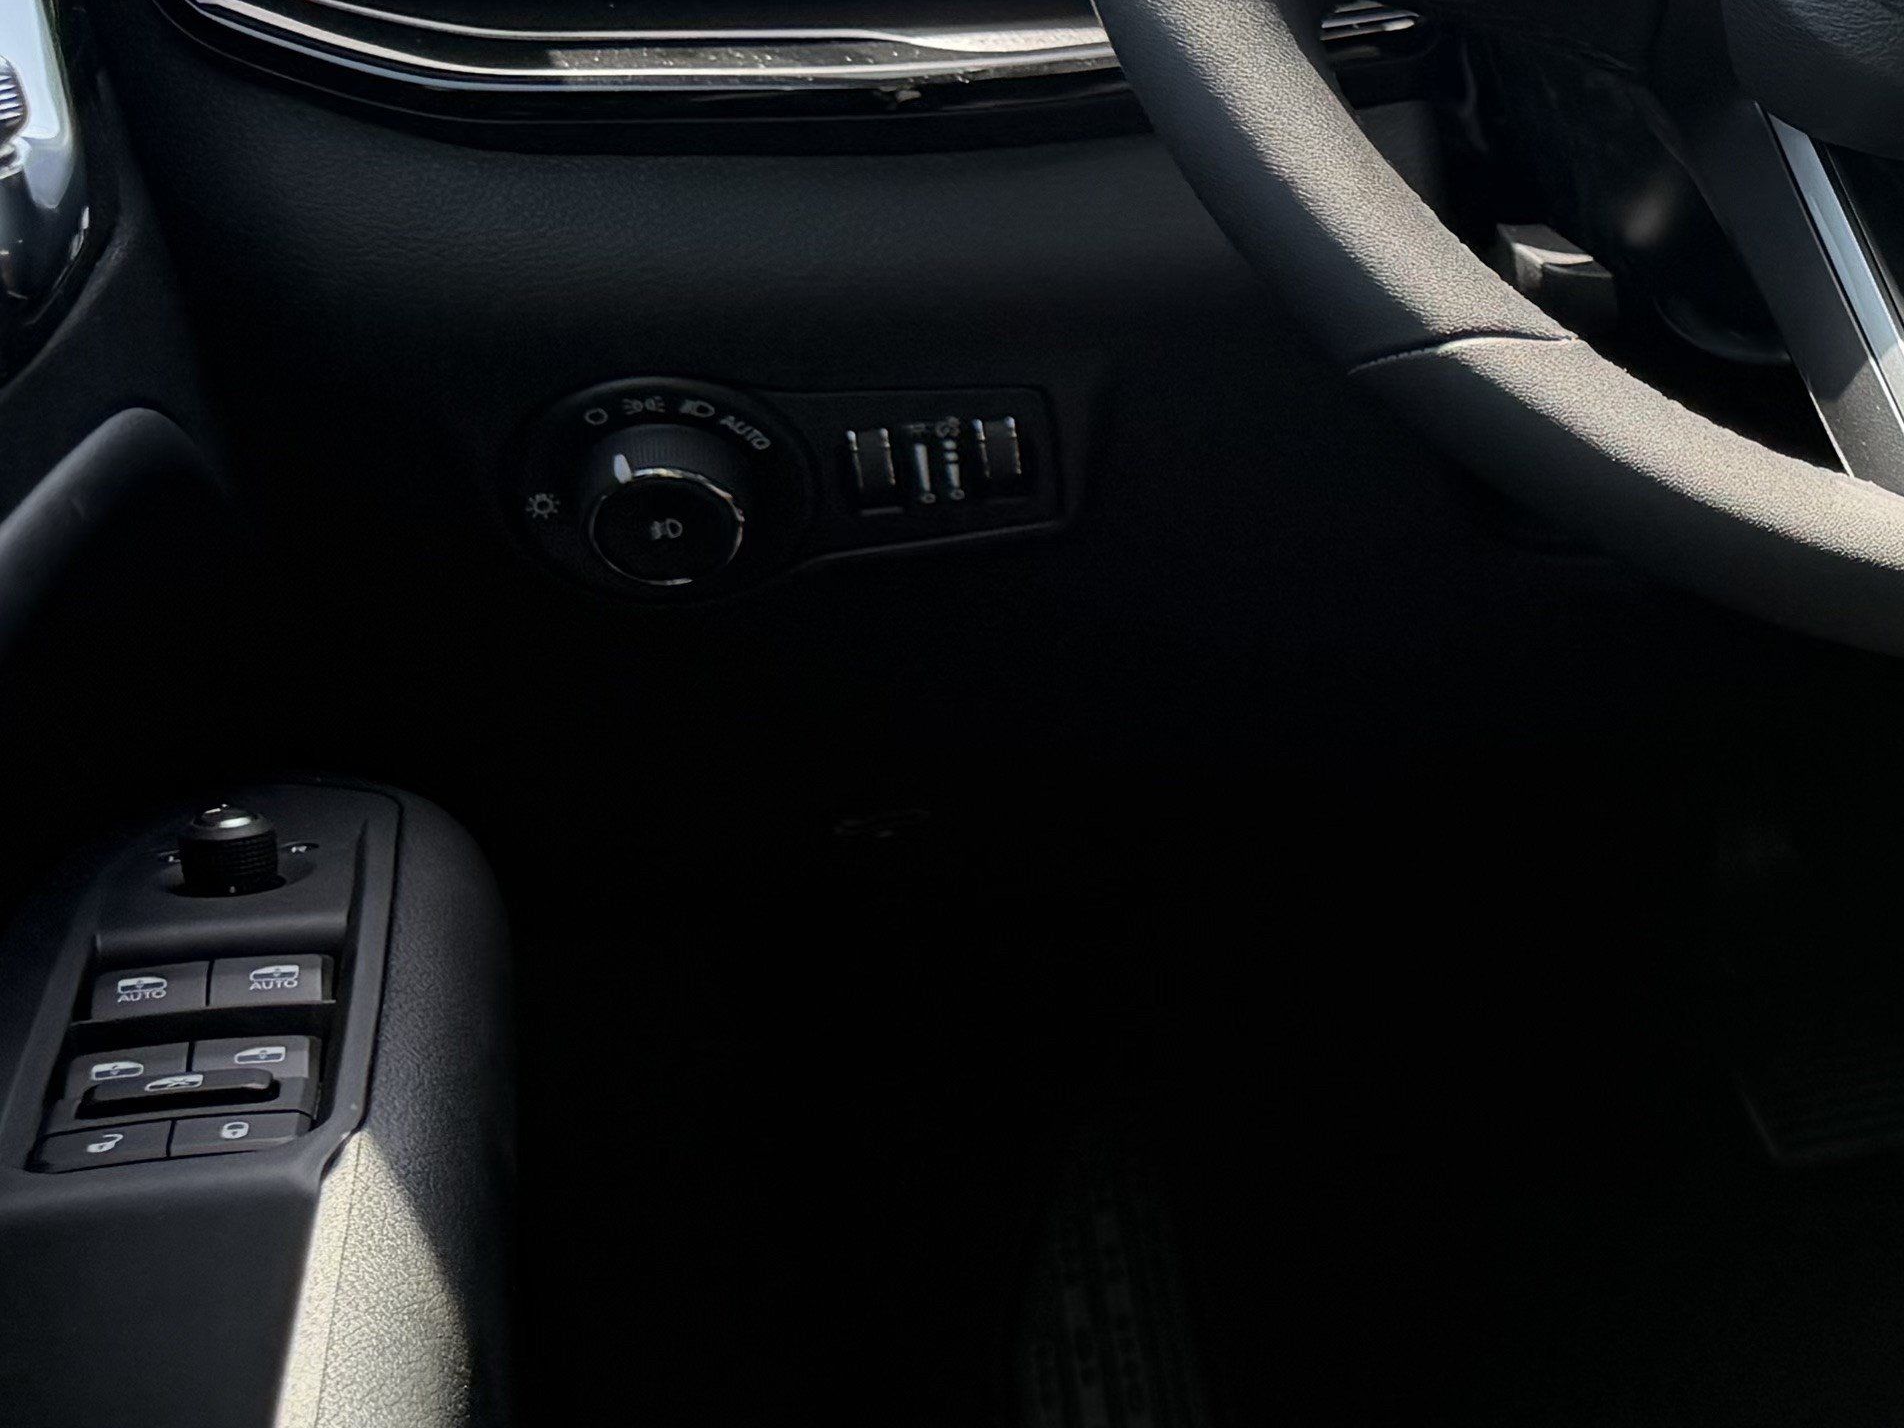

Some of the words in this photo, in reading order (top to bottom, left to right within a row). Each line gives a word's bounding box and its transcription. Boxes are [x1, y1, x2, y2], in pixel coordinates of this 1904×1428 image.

[720, 415, 771, 450] AUTO
[249, 977, 299, 991] AUTO
[117, 988, 167, 1002] AUTO
